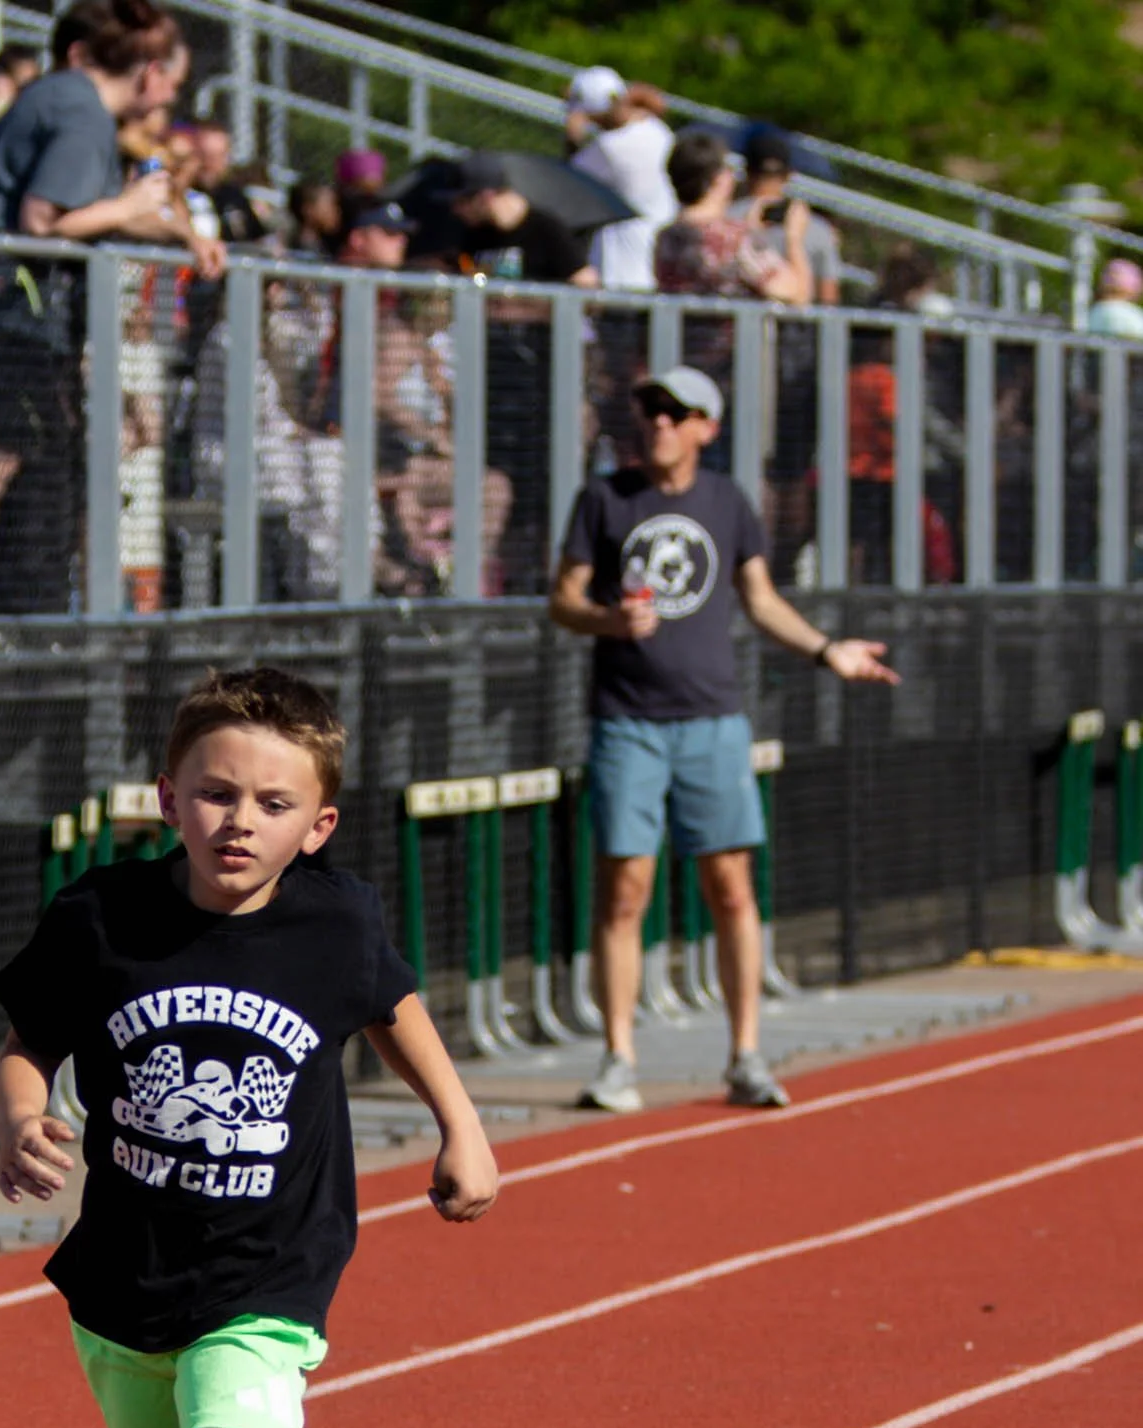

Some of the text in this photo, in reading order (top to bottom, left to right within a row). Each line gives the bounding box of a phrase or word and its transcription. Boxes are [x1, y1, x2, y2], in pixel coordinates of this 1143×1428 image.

[107, 987, 320, 1064] RIVERSIDE
[113, 1137, 275, 1197] RUN CLUB
